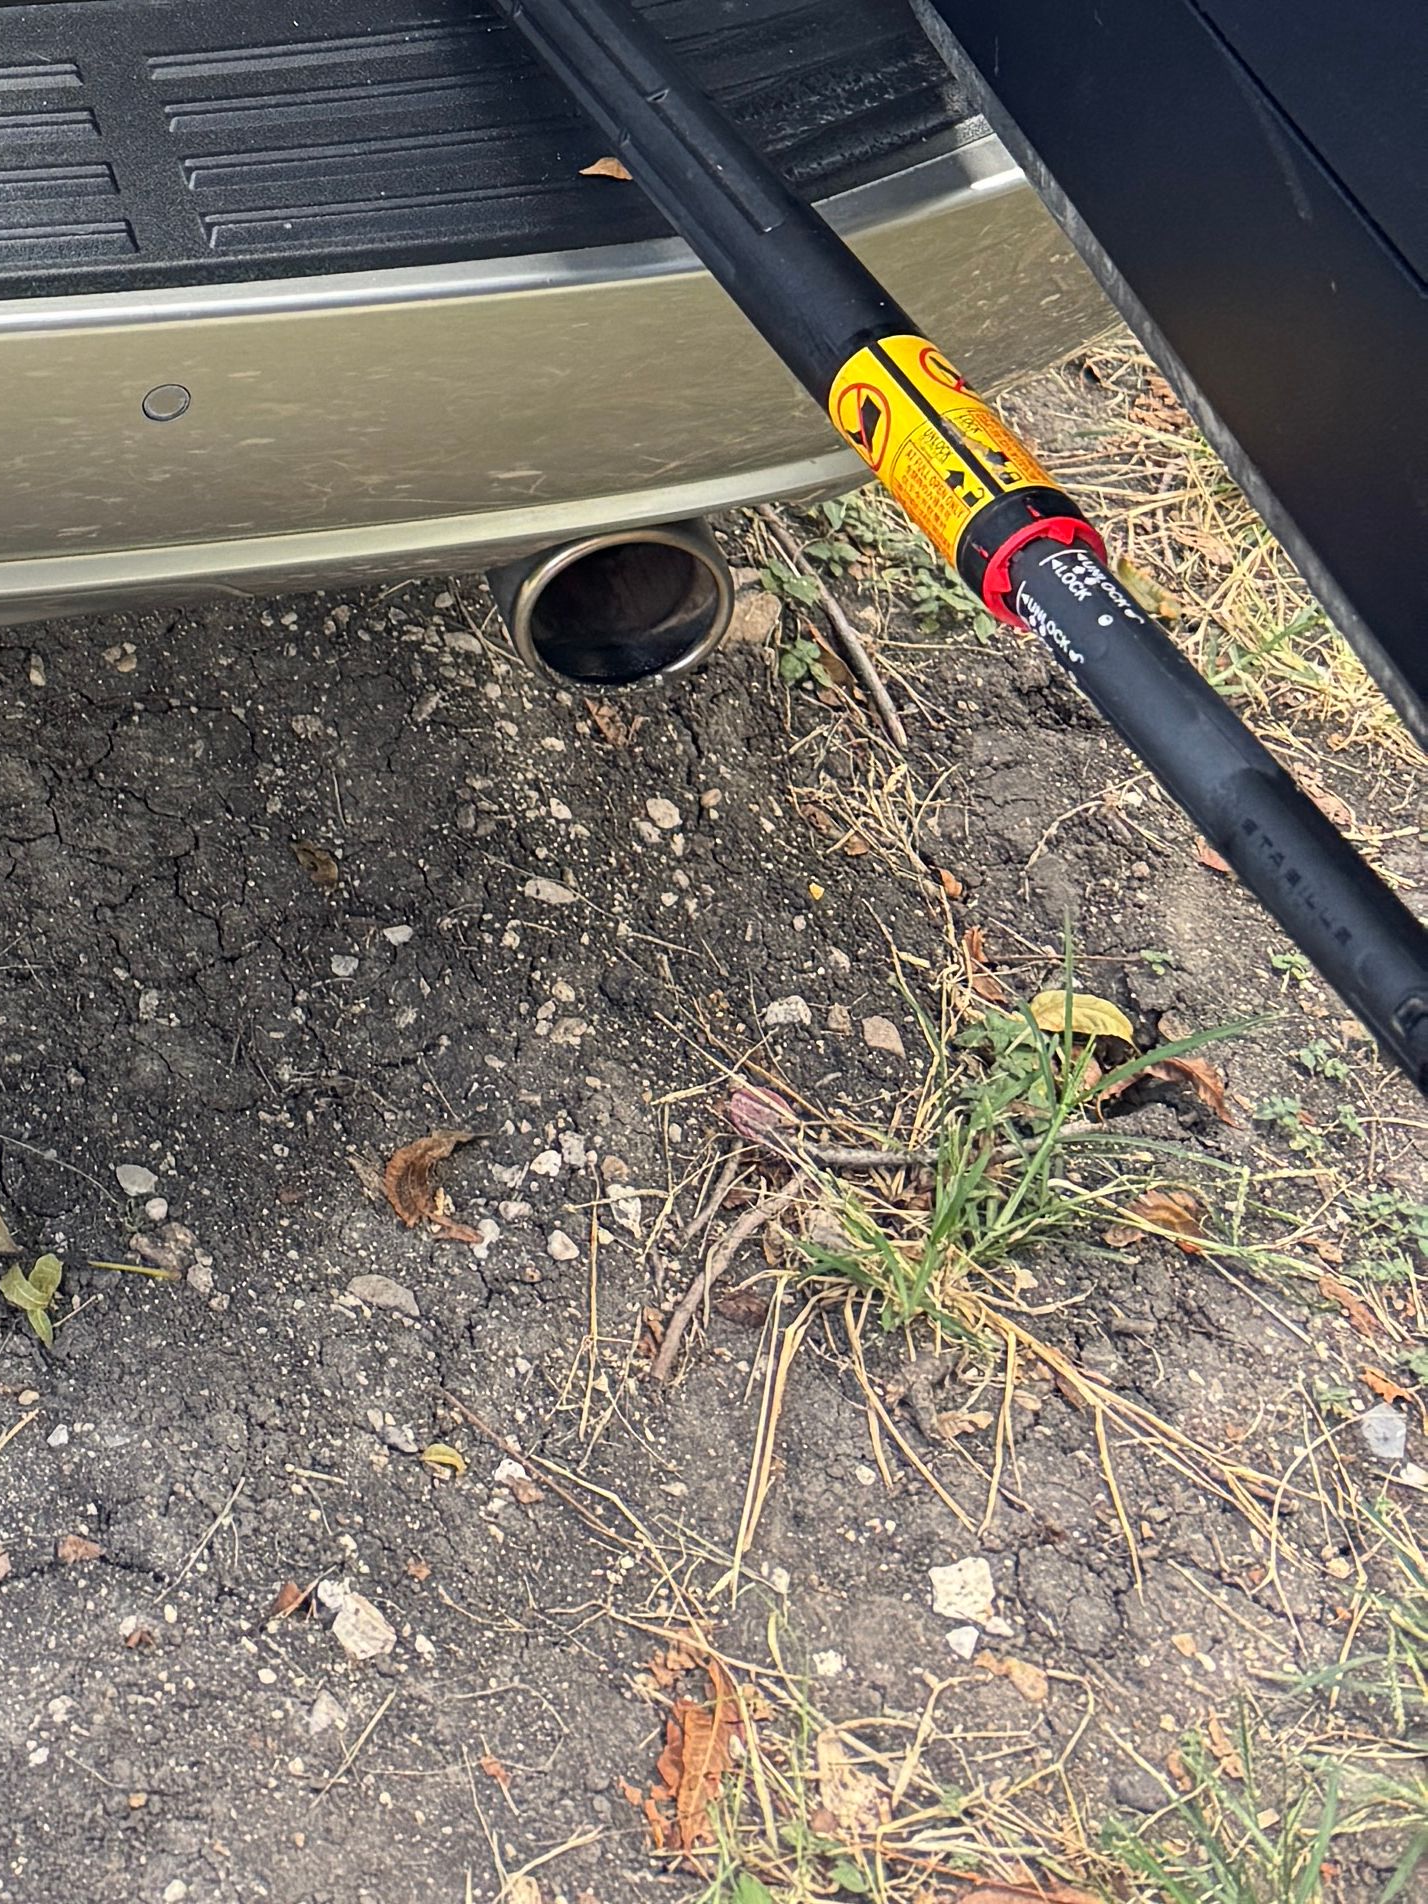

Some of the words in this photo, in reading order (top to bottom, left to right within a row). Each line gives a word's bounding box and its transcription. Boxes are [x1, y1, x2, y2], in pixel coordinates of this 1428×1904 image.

[921, 426, 954, 461] UNLOCK
[1055, 565, 1092, 601] LOCK
[1027, 597, 1071, 652] UNLOCK
